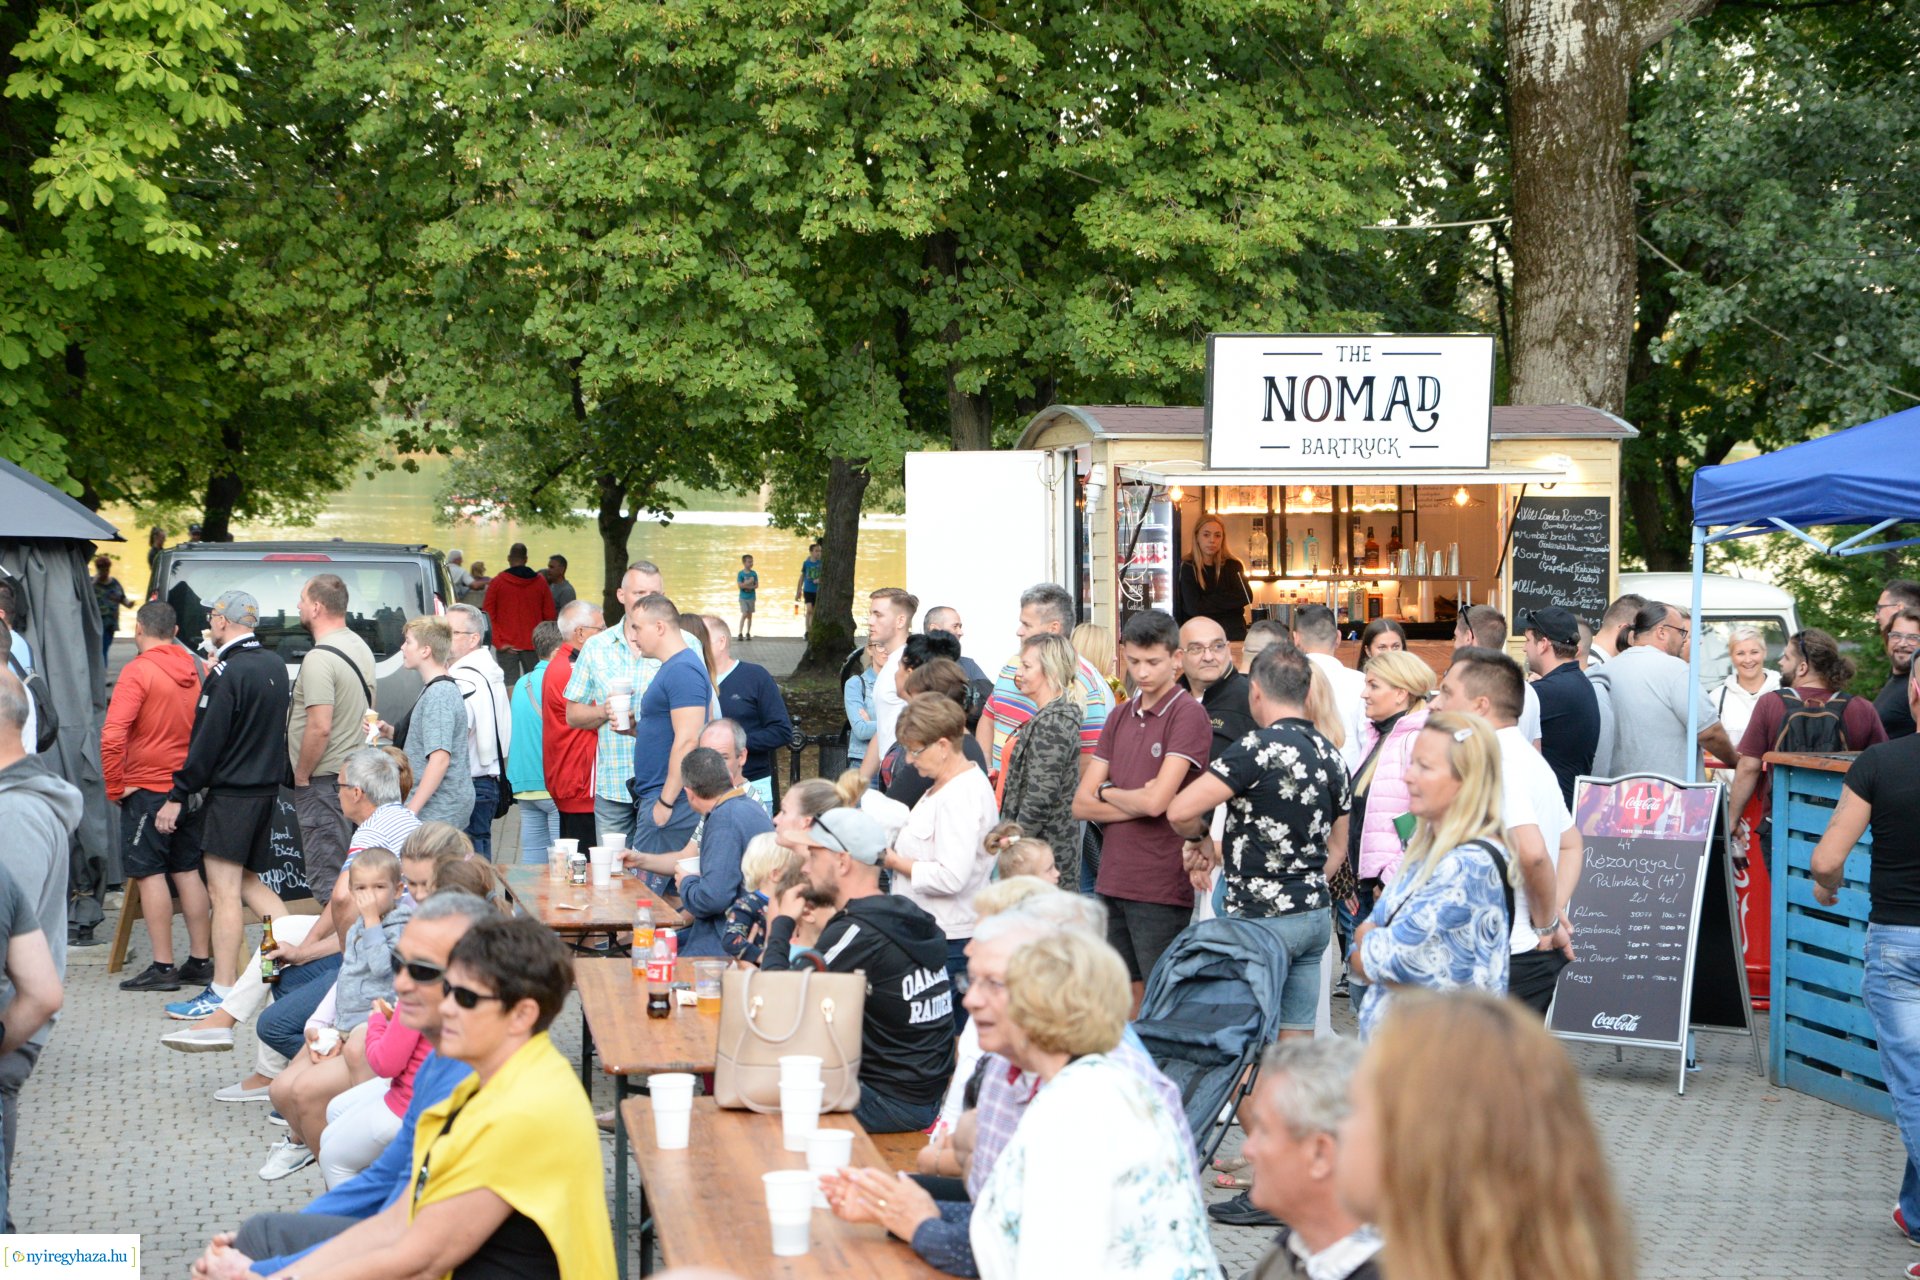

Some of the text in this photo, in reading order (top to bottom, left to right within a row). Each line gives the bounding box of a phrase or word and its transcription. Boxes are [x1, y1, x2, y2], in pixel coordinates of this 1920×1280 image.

[1336, 345, 1372, 362] THE
[1261, 374, 1441, 433] NOMAD
[1301, 438, 1402, 460] BARTRUCK
[1550, 531, 1577, 541] breath
[1518, 548, 1557, 564] Sour hug
[1629, 892, 1679, 904] 2cl 4cl
[1592, 1011, 1642, 1032] Coca-Cola
